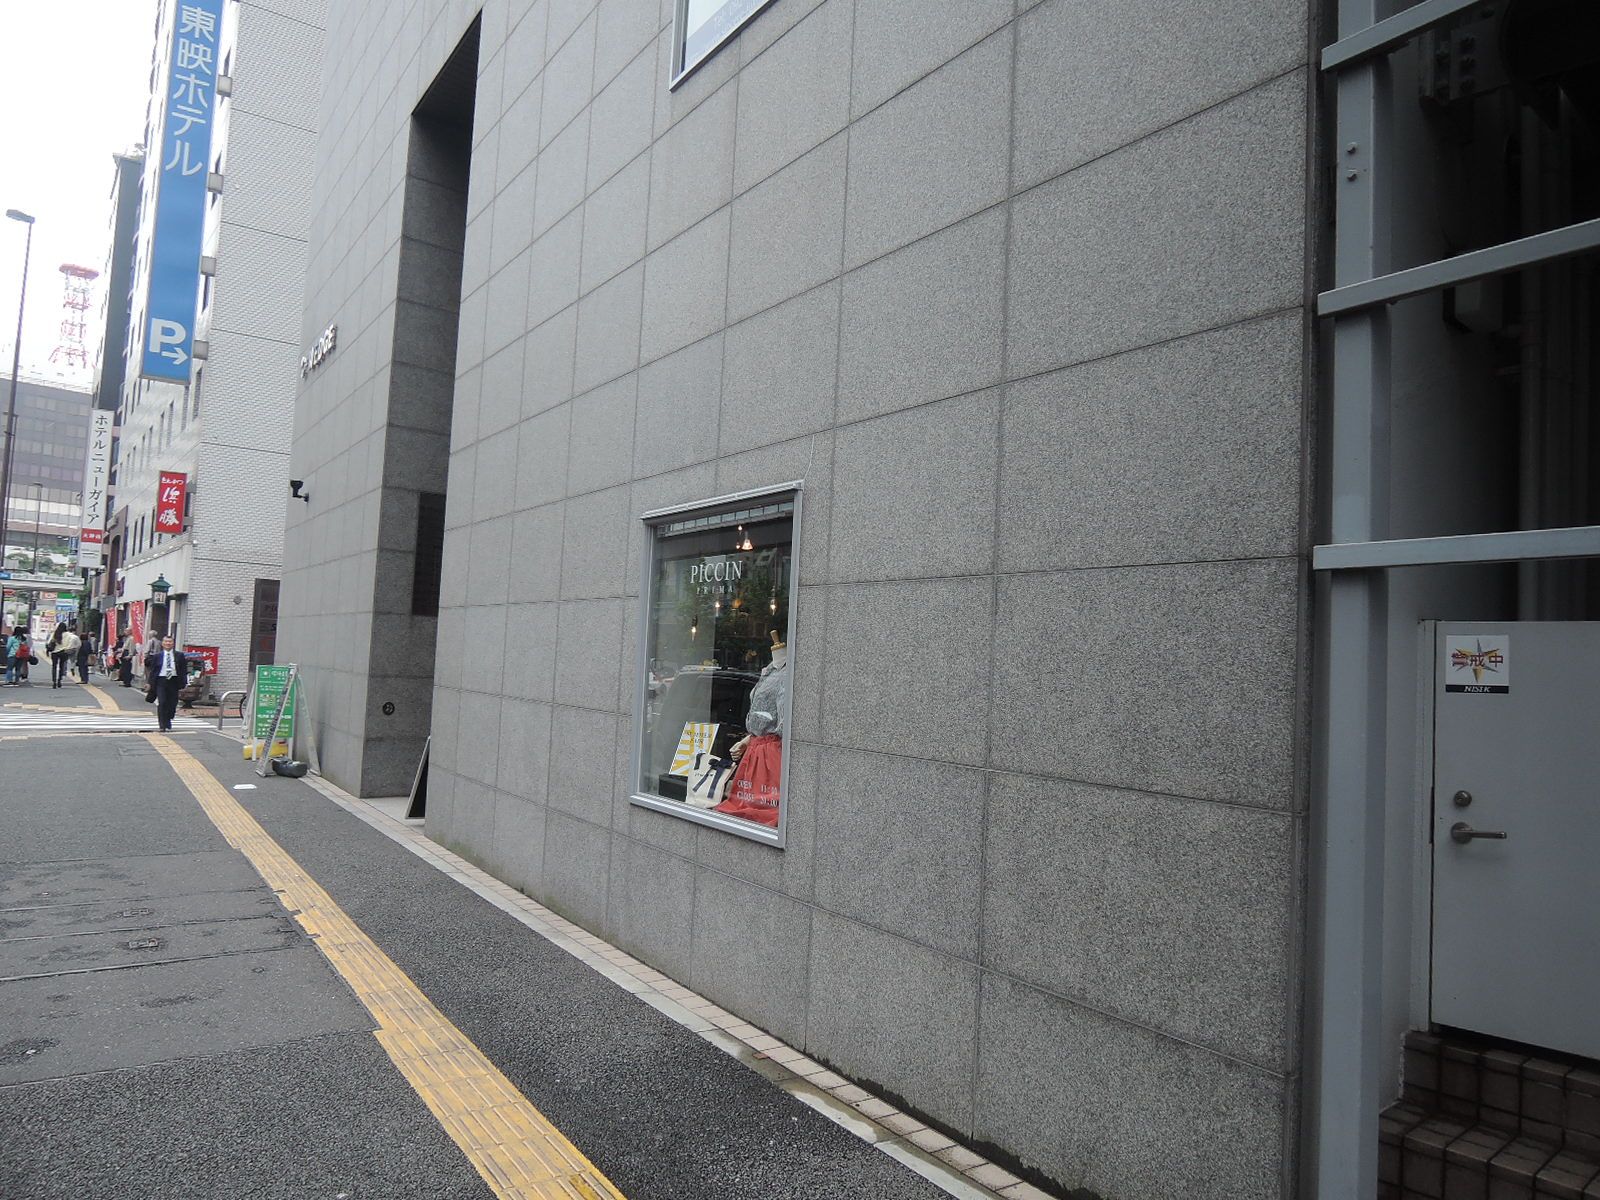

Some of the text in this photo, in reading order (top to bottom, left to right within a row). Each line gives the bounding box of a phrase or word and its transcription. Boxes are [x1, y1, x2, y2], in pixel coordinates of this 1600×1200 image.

[165, 4, 216, 177] 東映ホテル
[149, 318, 186, 354] P
[87, 414, 109, 526] ホテルニューガイア
[690, 560, 743, 584] PICCIN
[695, 585, 734, 595] PRIMA
